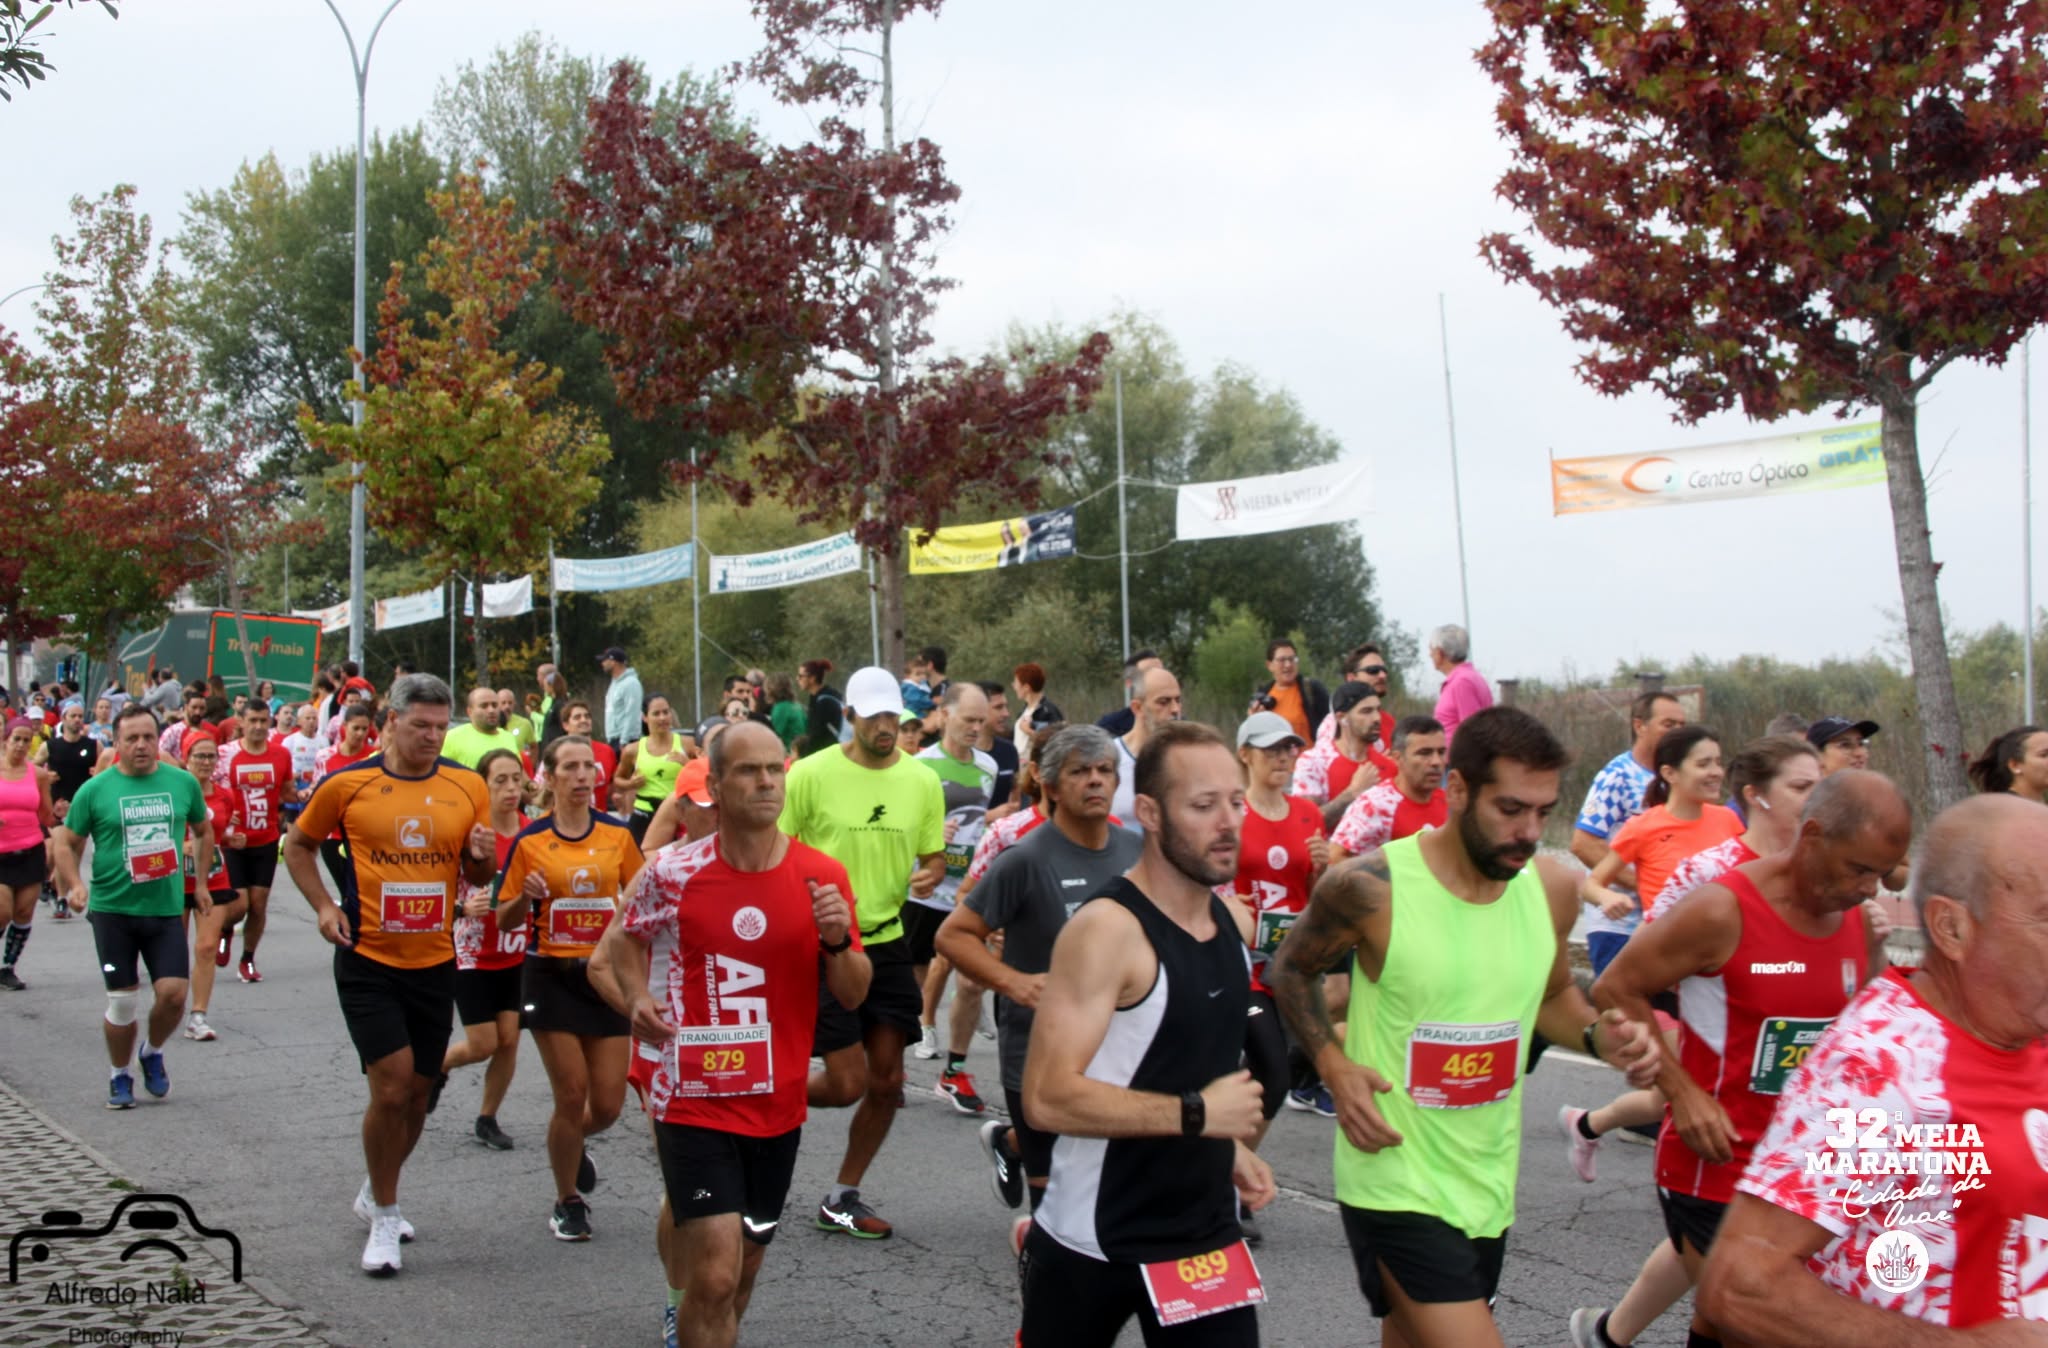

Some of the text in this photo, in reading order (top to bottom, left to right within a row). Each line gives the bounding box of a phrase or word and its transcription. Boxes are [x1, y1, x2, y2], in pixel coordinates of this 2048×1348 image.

[1749, 456, 1809, 487] Óptico
[124, 803, 171, 820] RUNNING
[149, 855, 164, 868] 36
[397, 899, 435, 915] 1127
[565, 913, 603, 927] 1122
[680, 1029, 767, 1043] TRANQUILIDADE
[1416, 1025, 1520, 1042] TRANQUILIDADE
[703, 1049, 746, 1071] 879
[1442, 1052, 1495, 1077] 462
[1177, 1249, 1229, 1284] 689
